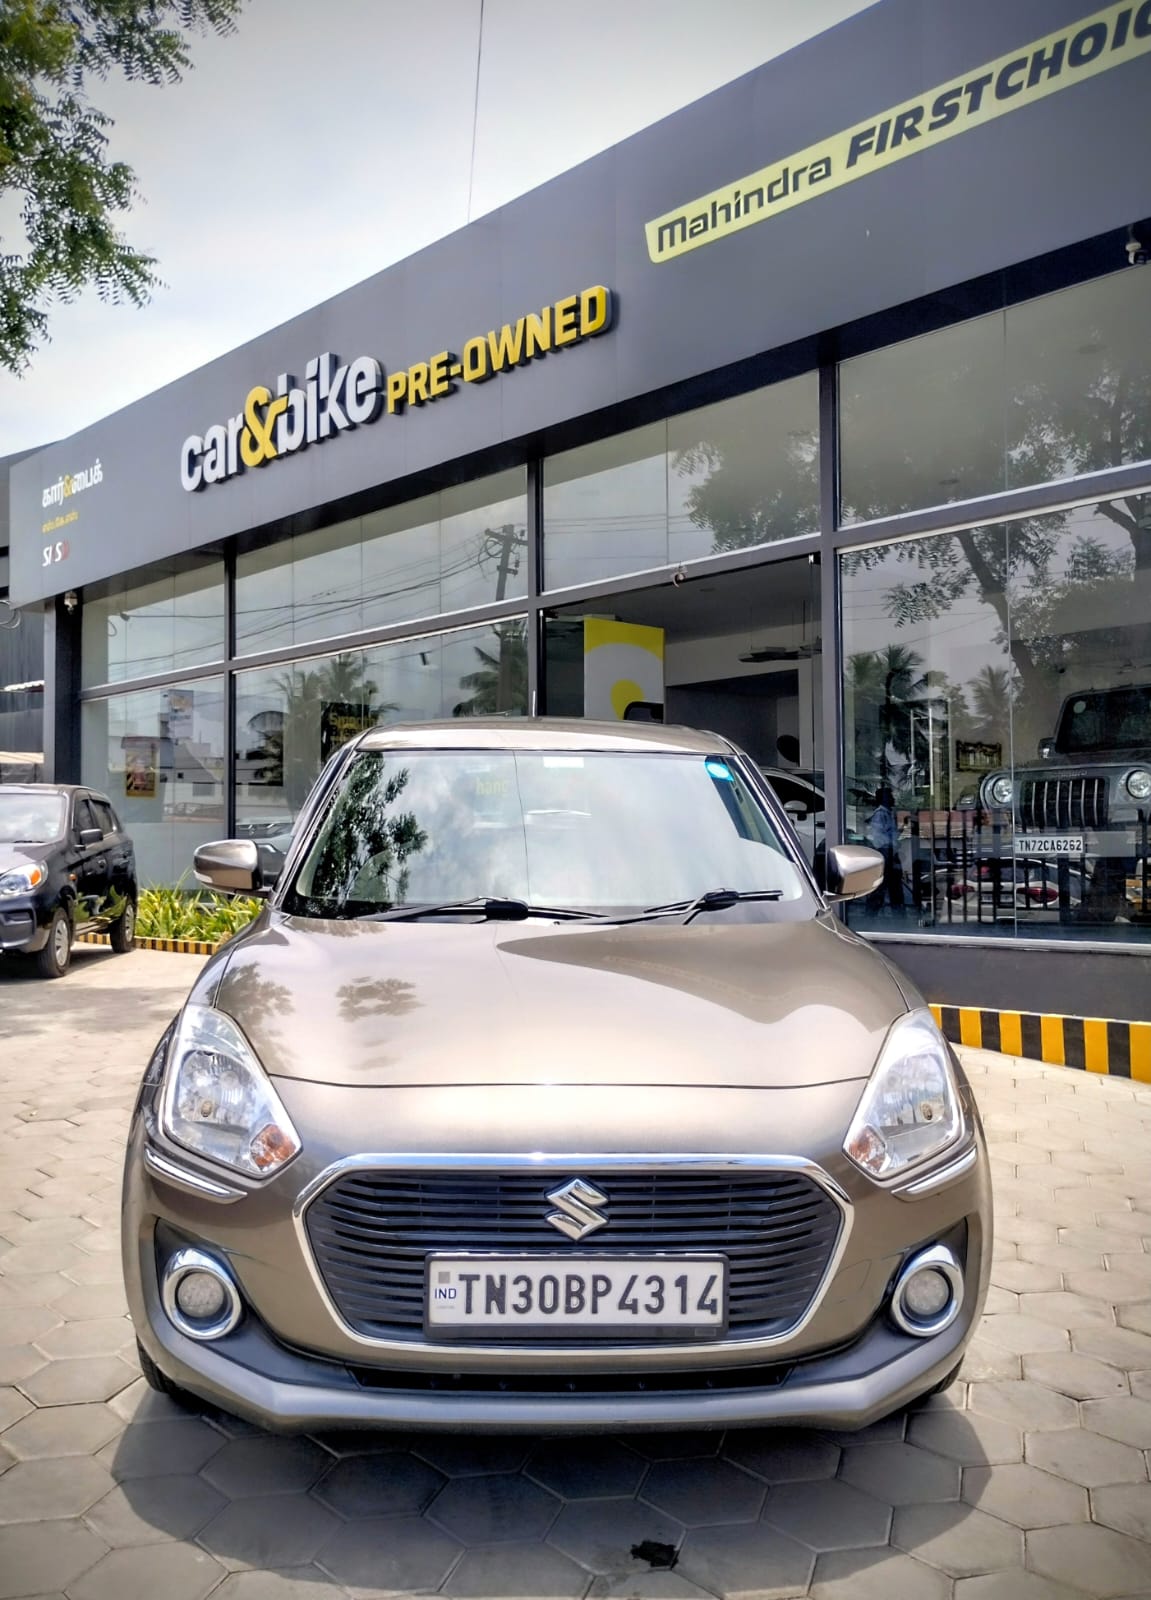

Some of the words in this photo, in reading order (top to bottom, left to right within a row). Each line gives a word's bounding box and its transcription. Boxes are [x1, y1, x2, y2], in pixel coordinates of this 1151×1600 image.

[657, 156, 832, 253] Mahindra
[180, 352, 385, 492] car&bike
[387, 285, 613, 414] PRE-OWNED
[1019, 840, 1082, 851] TN72CA6262
[434, 1288, 457, 1299] IND
[458, 1273, 718, 1315] TN30BP4314
